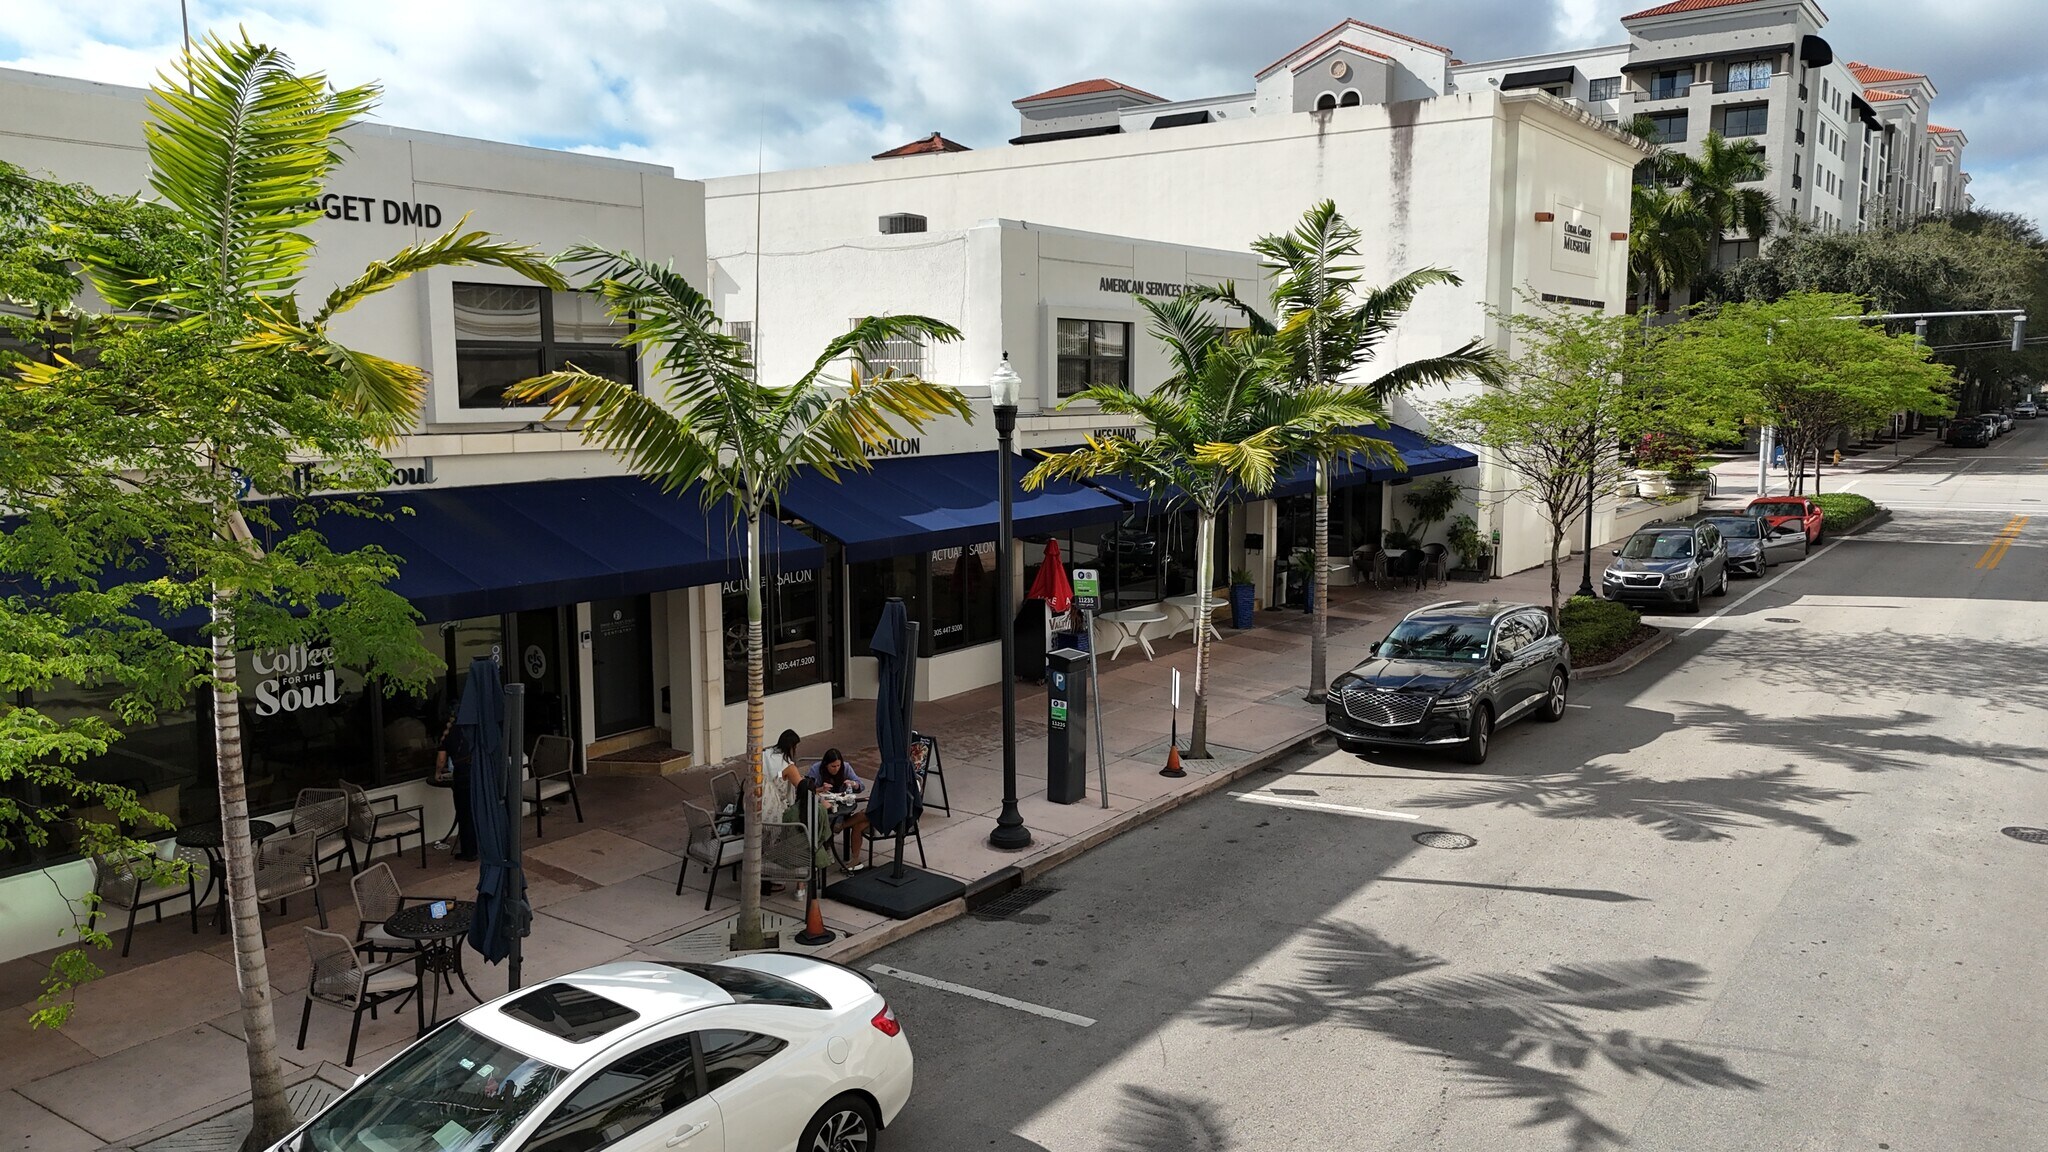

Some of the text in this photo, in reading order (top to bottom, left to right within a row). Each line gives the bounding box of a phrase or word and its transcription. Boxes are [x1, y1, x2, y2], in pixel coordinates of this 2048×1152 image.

[383, 200, 442, 228] DMD
[1563, 236, 1591, 254] MUSEUM
[1099, 277, 1144, 294] AMERICAN
[1145, 281, 1181, 298] SERVICES
[1093, 428, 1136, 443] MESAMAR
[878, 437, 920, 457] SALON
[931, 547, 960, 562] ACTUA
[969, 541, 995, 556] SALON
[777, 569, 812, 586] SALON
[777, 655, 815, 671] 305.447.9200
[282, 673, 321, 686] FOR THE
[1056, 673, 1064, 687] P
[255, 669, 341, 716] Soul
